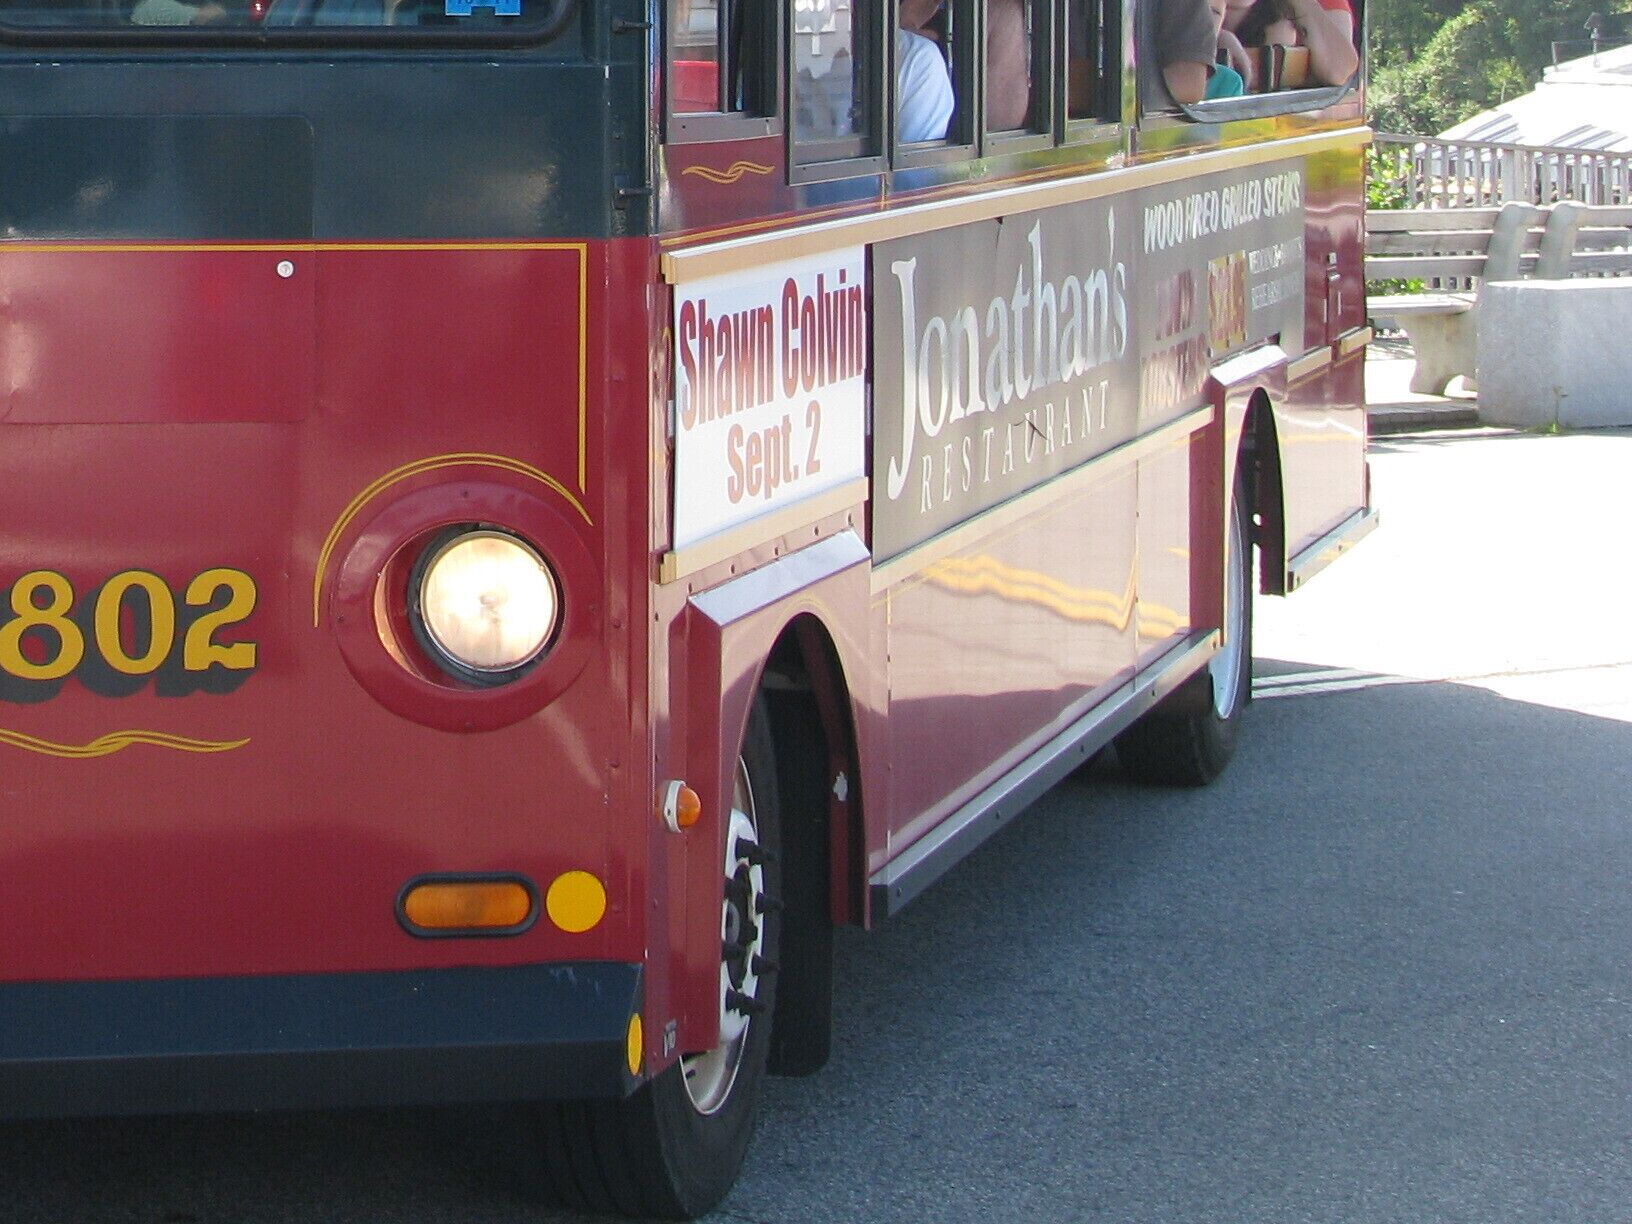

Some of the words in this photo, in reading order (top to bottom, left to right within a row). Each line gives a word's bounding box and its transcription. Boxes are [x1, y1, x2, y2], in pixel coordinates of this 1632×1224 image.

[1144, 199, 1183, 255] WOOD
[679, 298, 774, 431] Shawn
[781, 269, 863, 399] Colvin
[888, 205, 1128, 500] Jonathan's
[727, 414, 800, 504] Sept.
[805, 399, 821, 477] 2
[920, 379, 1110, 514] RESTAURANT
